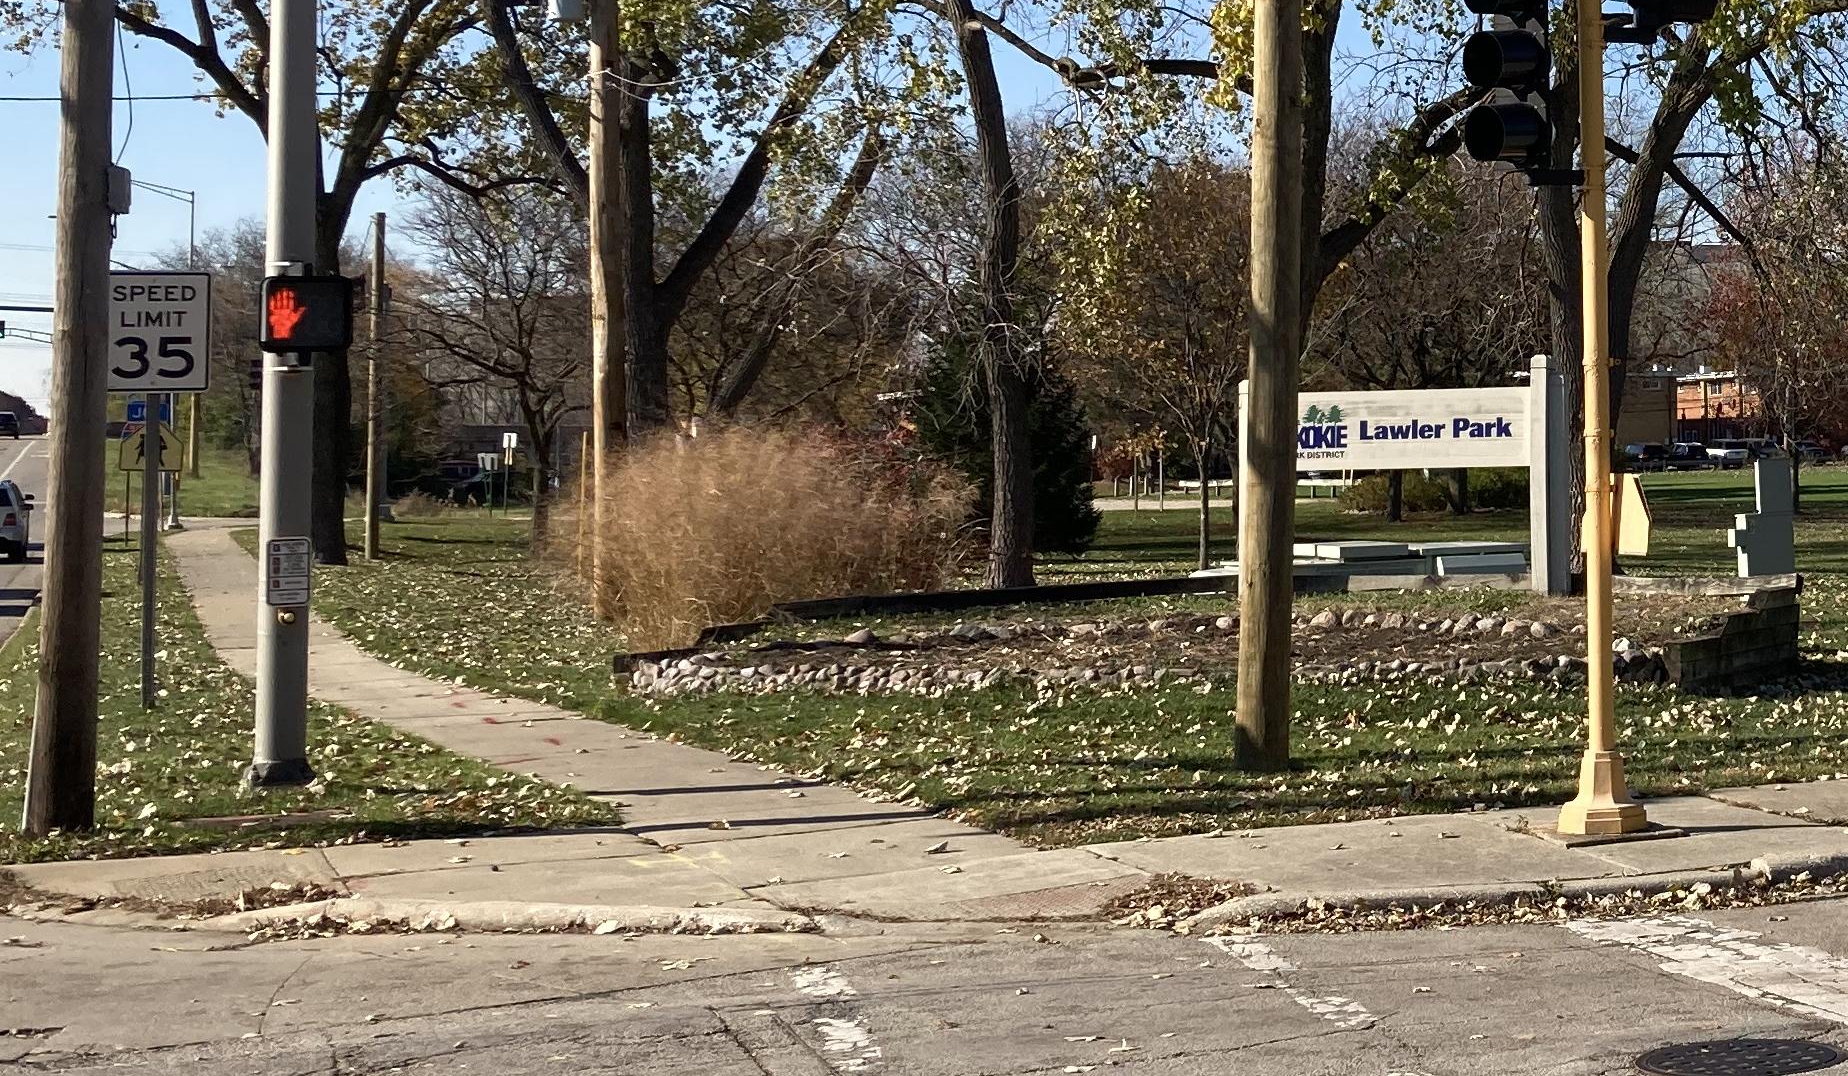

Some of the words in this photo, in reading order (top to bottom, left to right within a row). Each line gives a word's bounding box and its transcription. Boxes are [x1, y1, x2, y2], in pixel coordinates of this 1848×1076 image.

[113, 285, 196, 302] SPEED
[120, 311, 187, 328] LIMIT
[111, 336, 194, 379] 35
[1296, 425, 1347, 449] KOKIE
[1360, 419, 1445, 440] Lawler
[1453, 417, 1512, 438] Park
[1306, 450, 1345, 459] DISTRICT
